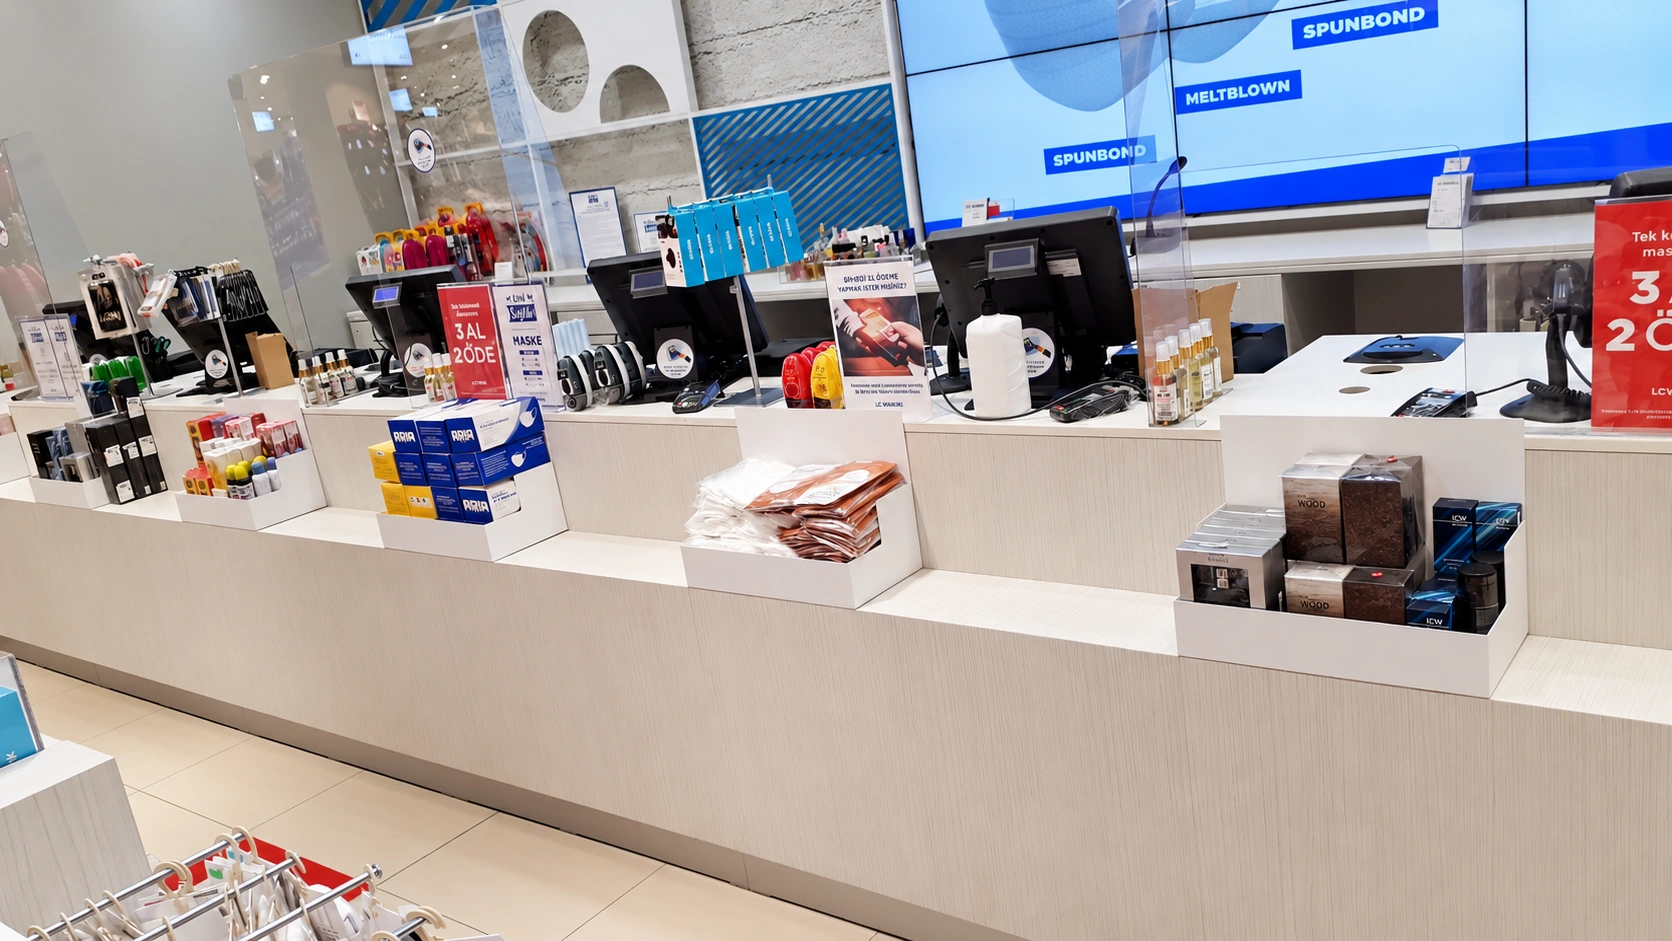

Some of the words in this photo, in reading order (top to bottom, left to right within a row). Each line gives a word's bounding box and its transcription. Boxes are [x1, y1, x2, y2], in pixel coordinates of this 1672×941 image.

[1303, 7, 1425, 39] SPUNBOND
[1186, 79, 1290, 106] MELTBLOWN
[1053, 144, 1147, 166] SPUNBOND
[1631, 230, 1657, 242] Tek
[1661, 229, 1672, 241] k
[1629, 270, 1660, 304] 3
[454, 323, 465, 340] 3
[466, 322, 487, 340] AL
[513, 335, 543, 346] MASKE
[1606, 318, 1636, 352] 2
[453, 347, 464, 364] 2
[463, 342, 497, 364] ÖDE
[1297, 500, 1326, 508] WOOD
[1300, 600, 1329, 610] WOOD
